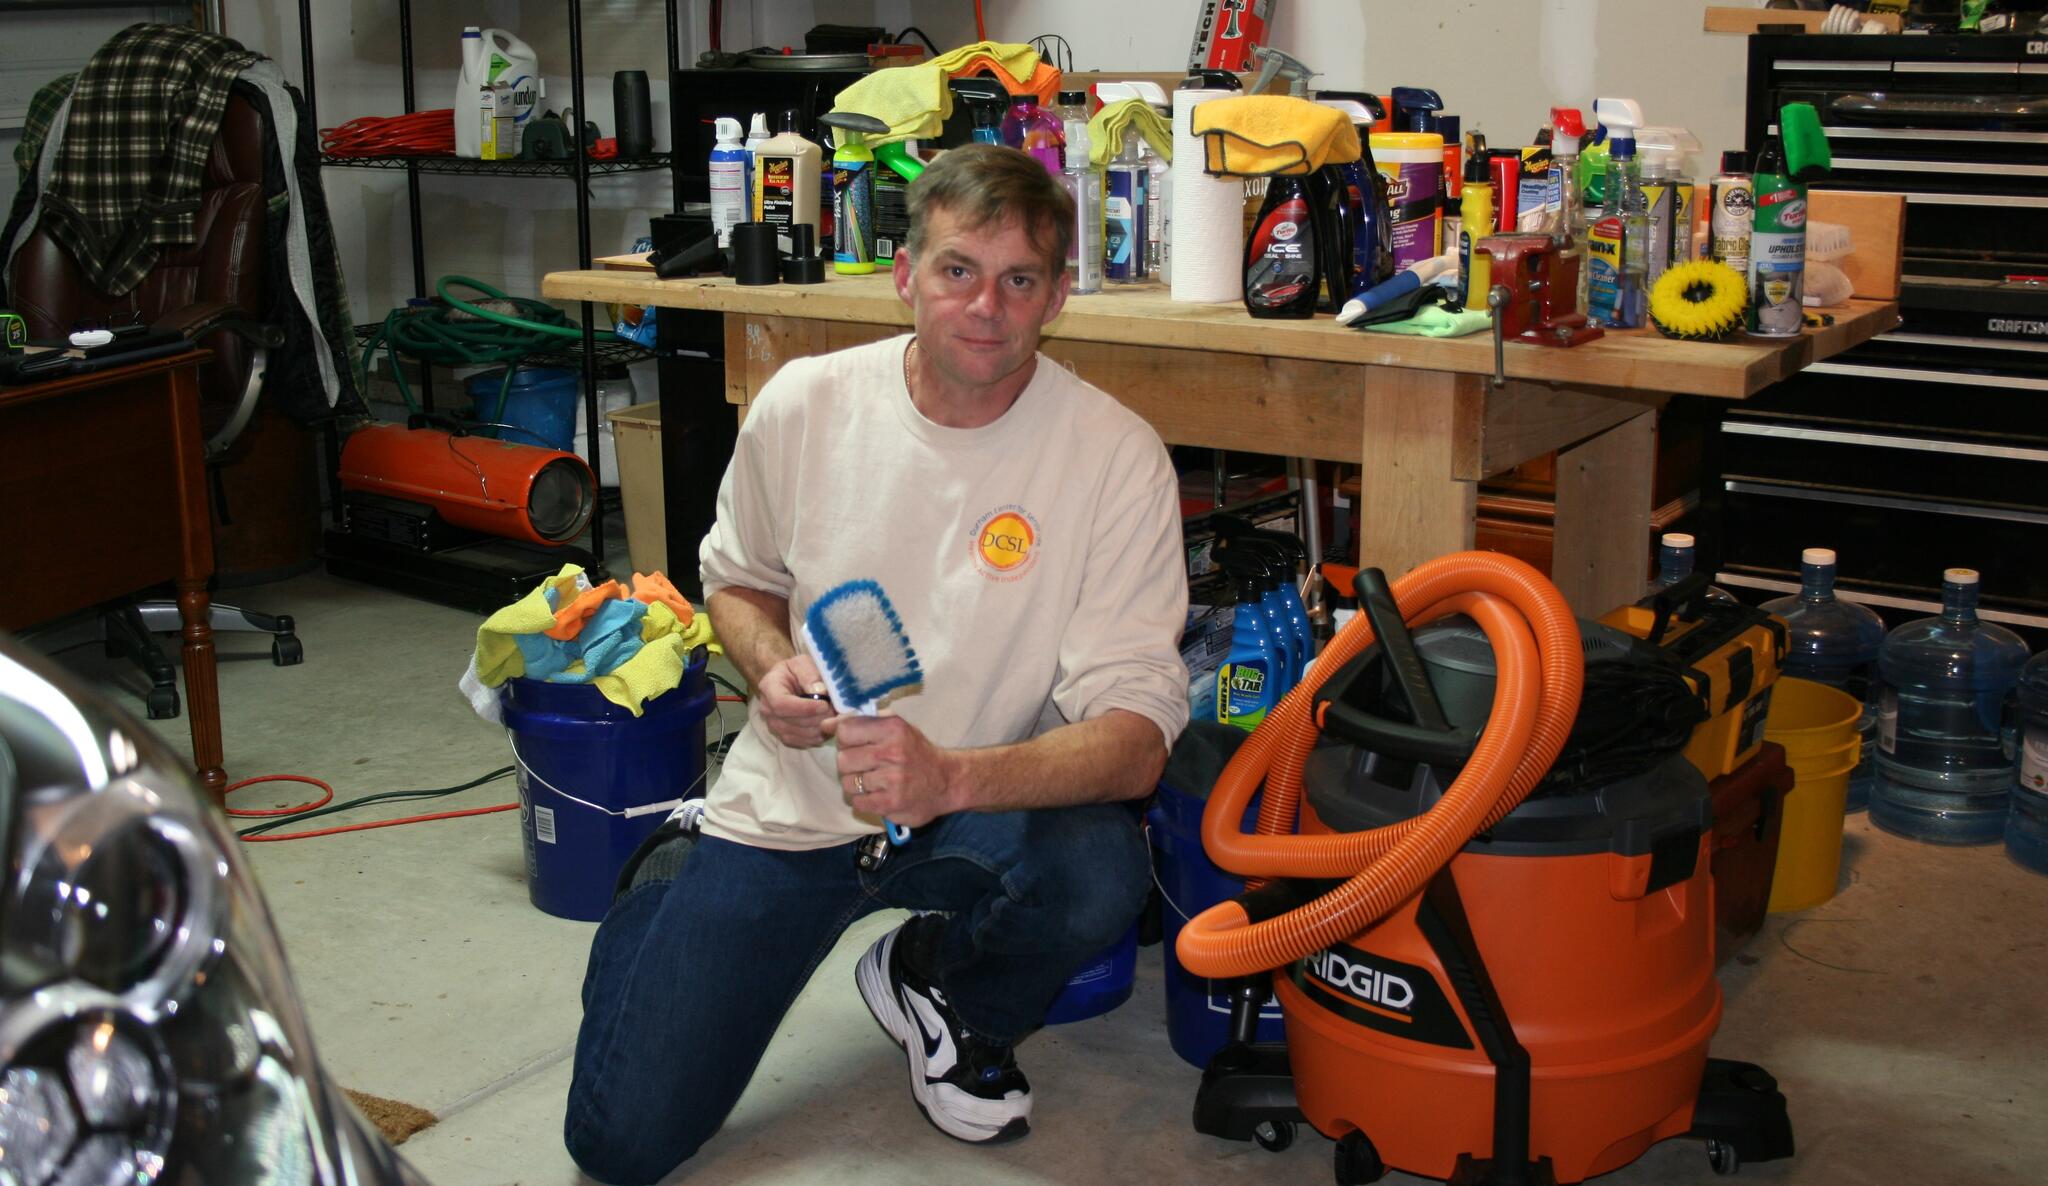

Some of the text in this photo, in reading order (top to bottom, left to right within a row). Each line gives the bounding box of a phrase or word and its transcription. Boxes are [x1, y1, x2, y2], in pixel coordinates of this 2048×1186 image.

[1196, 2, 1216, 56] TECH
[514, 86, 537, 107] undup
[1387, 185, 1404, 195] ALL
[1267, 244, 1302, 252] ICE
[982, 532, 1027, 553] DCSL
[1240, 679, 1262, 692] TAR
[1304, 951, 1414, 1009] RIDGID
